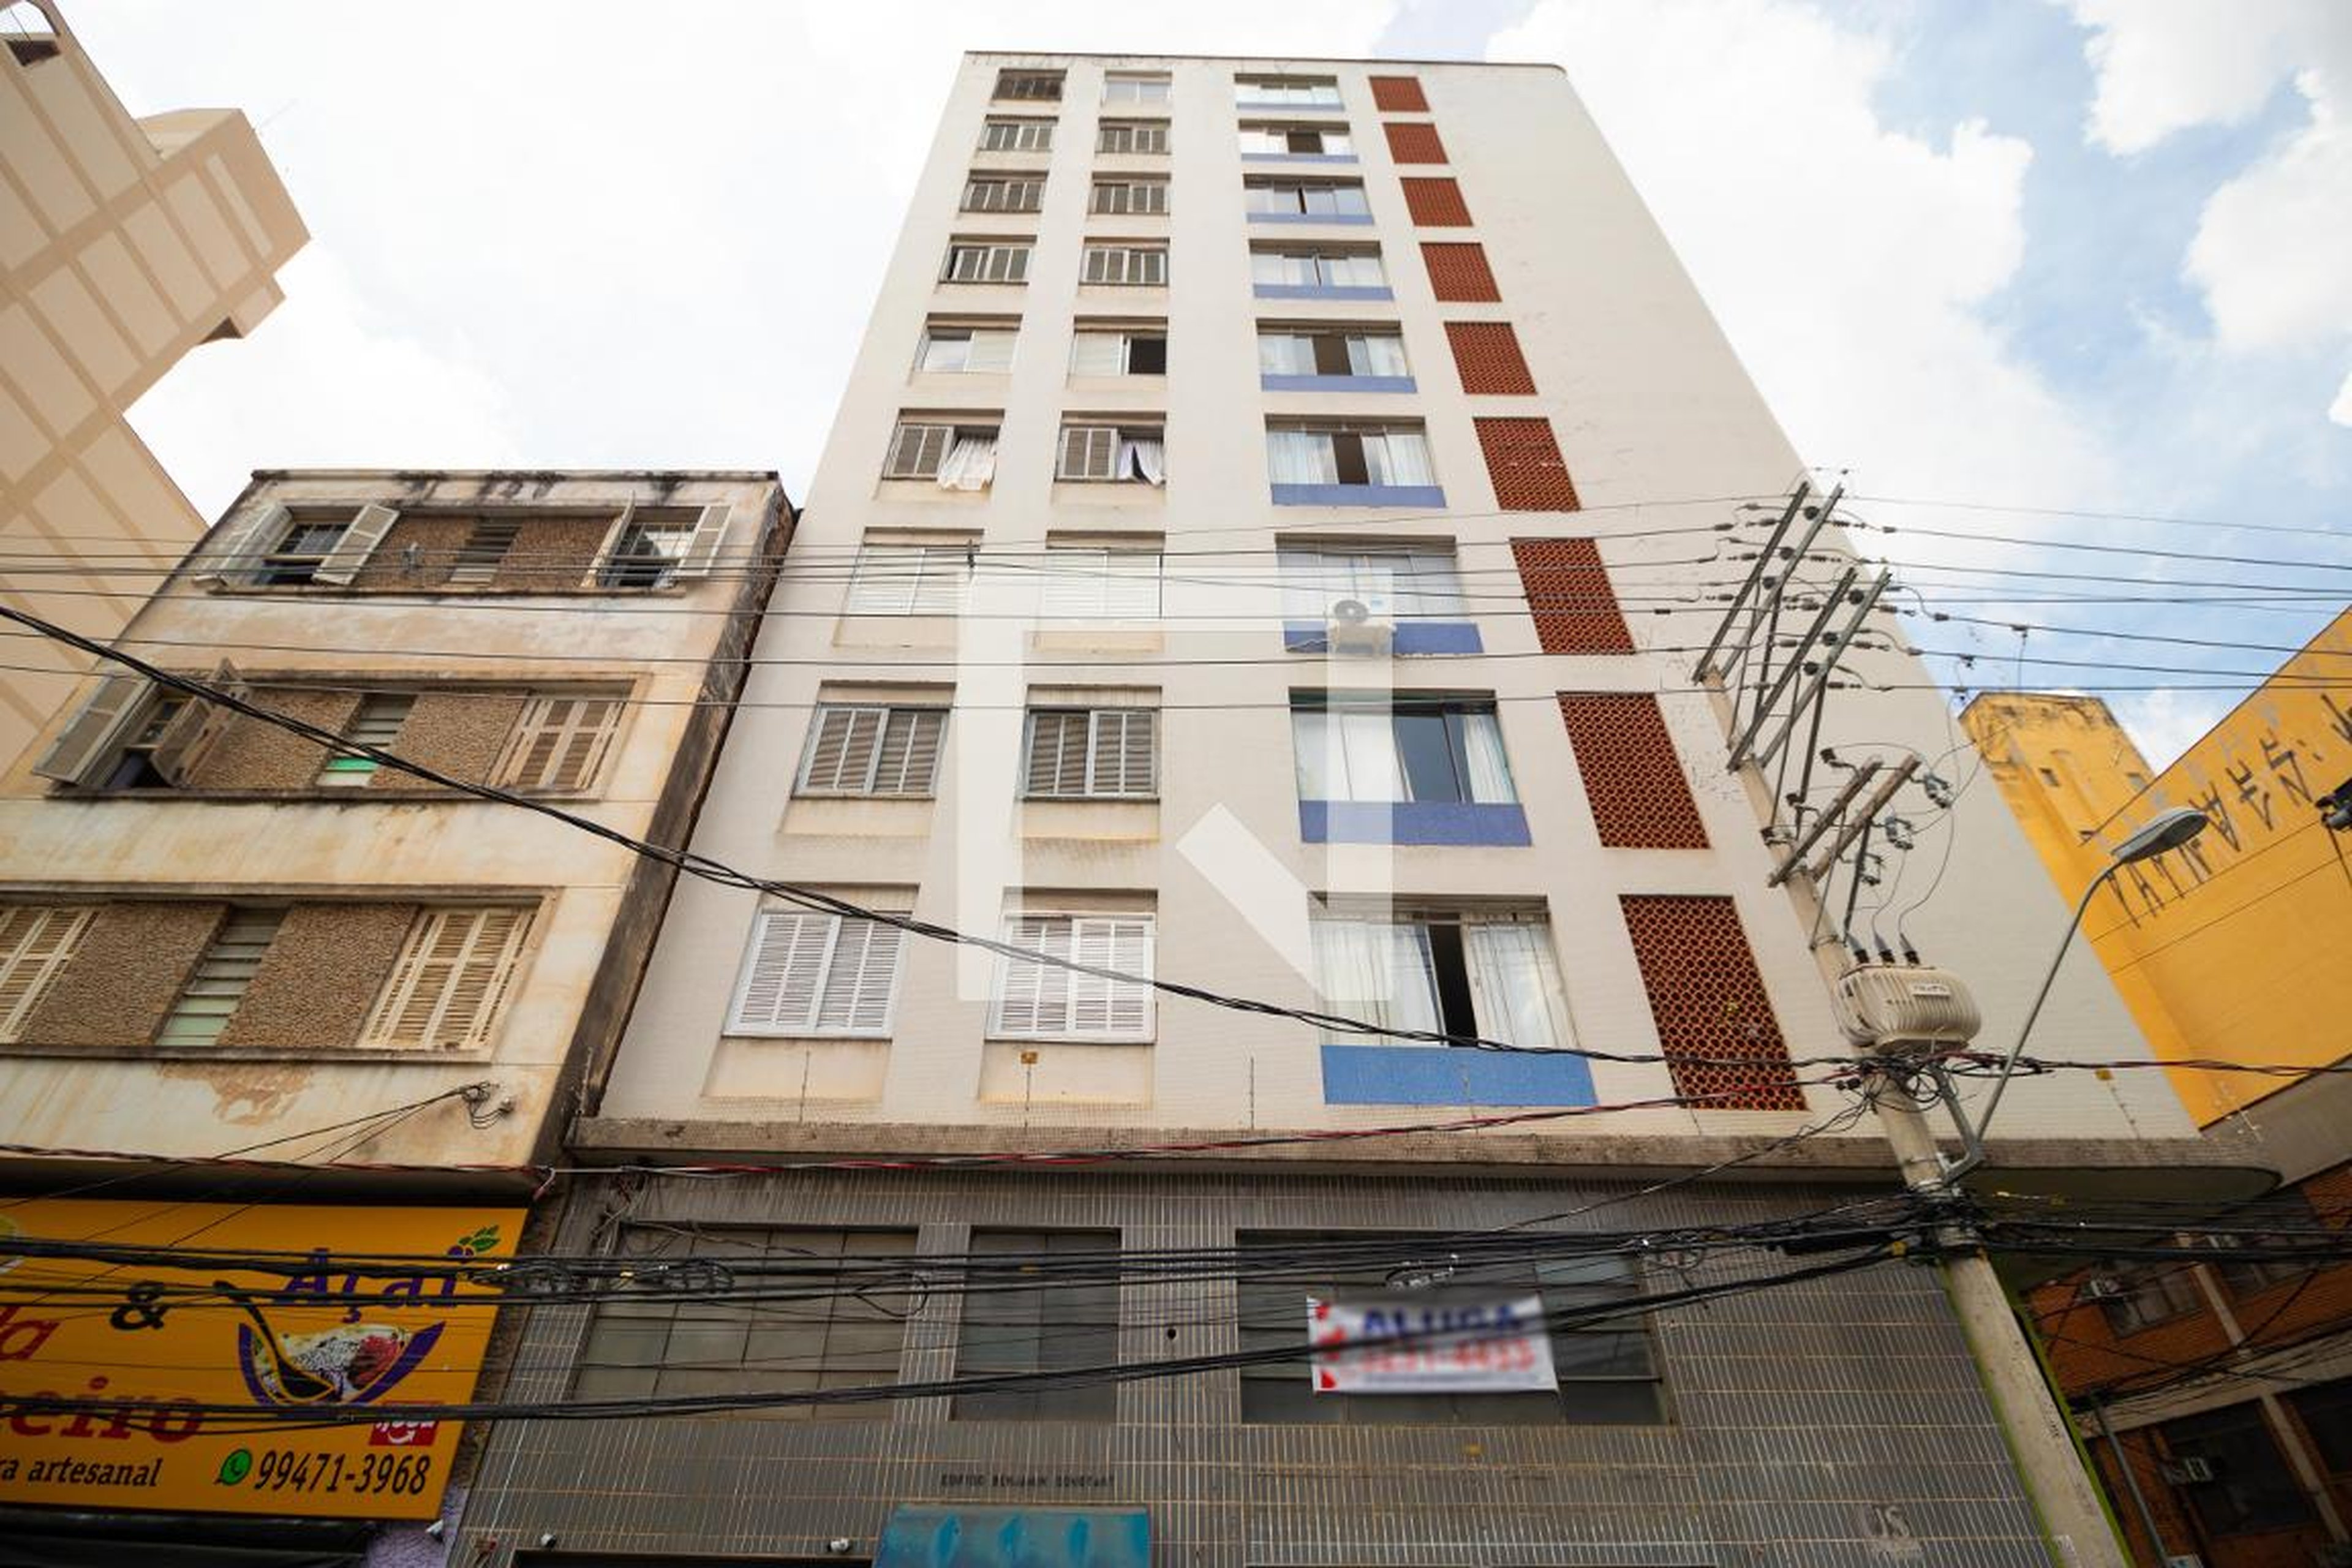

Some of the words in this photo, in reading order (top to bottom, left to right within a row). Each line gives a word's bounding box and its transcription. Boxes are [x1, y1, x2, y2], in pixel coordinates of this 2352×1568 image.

[110, 1280, 168, 1330] &
[28, 1457, 164, 1487] artesanal
[254, 1450, 431, 1495] 99471-3968
